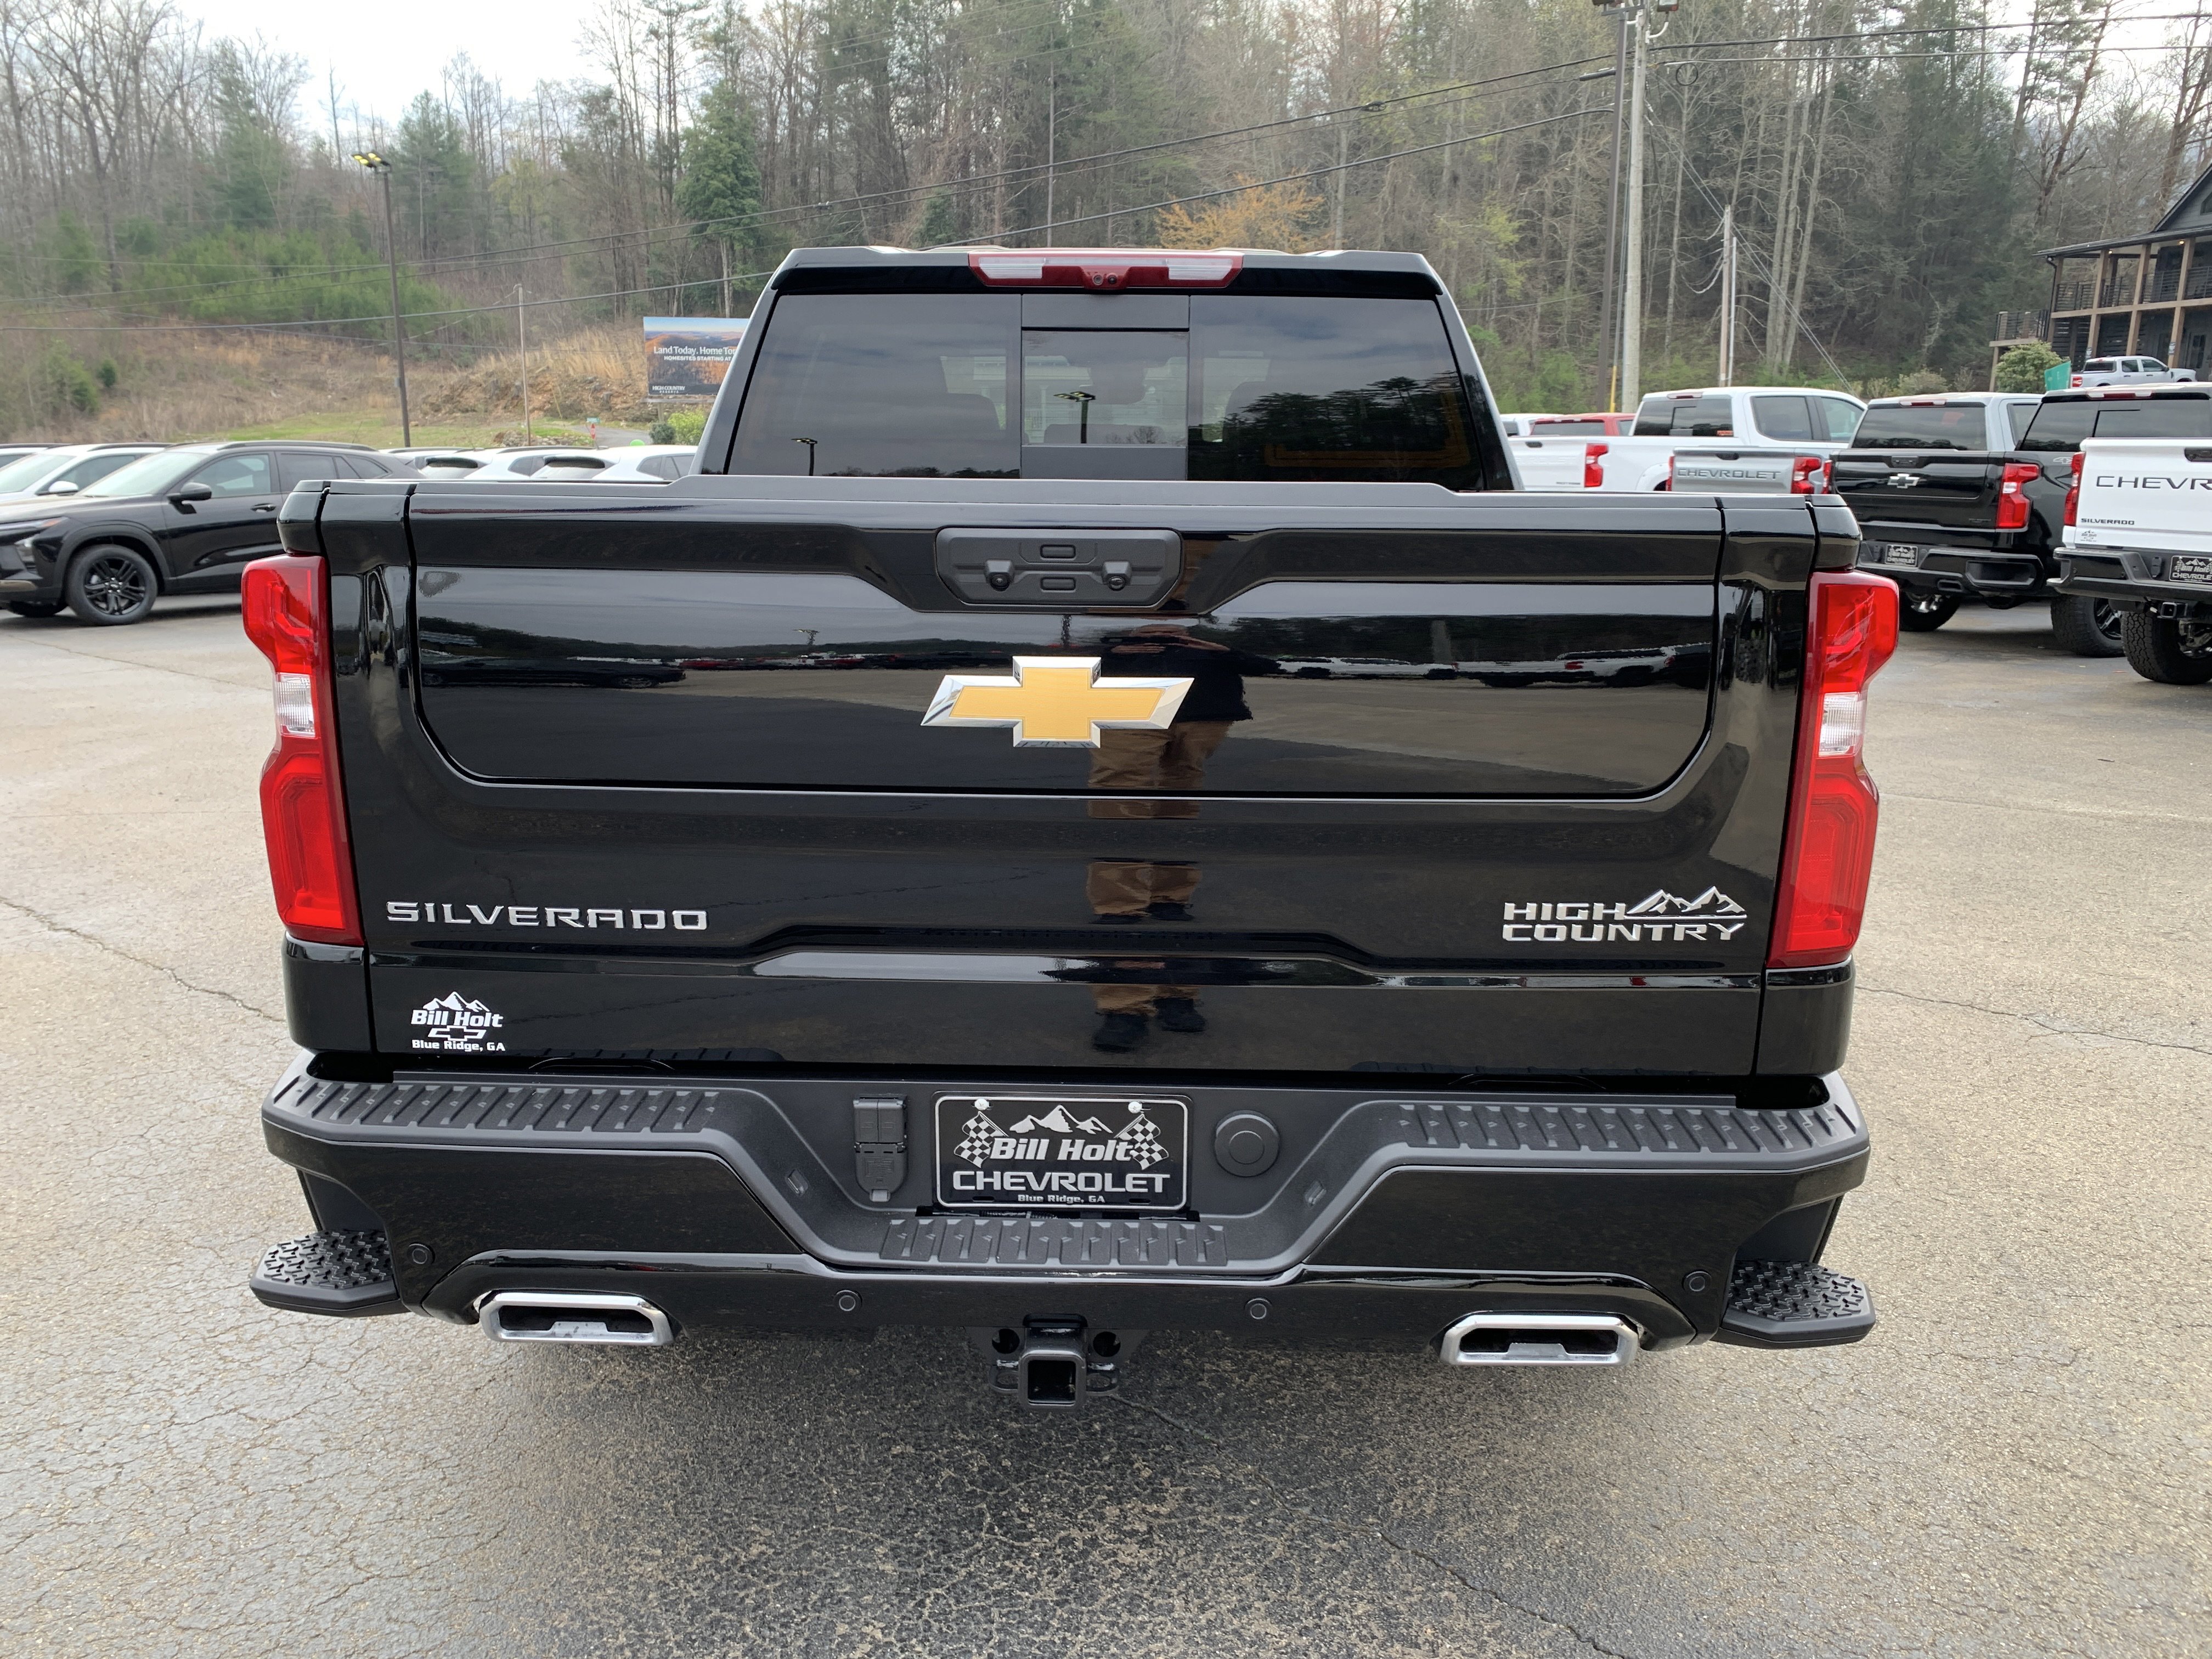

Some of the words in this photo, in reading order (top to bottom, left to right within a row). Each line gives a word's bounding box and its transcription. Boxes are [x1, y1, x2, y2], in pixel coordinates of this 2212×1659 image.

[653, 345, 673, 354] Land
[673, 346, 698, 356] Today.
[699, 346, 723, 354] Home
[1677, 469, 1781, 479] CHEVROLET
[2096, 476, 2212, 490] CHEVR
[387, 901, 708, 930] SILVERADO
[1503, 902, 1626, 921] HIGH
[1502, 923, 1745, 941] COUNTRY
[411, 1009, 449, 1025] Bill
[453, 1011, 504, 1028] Holt
[412, 1040, 440, 1049] Blue
[444, 1041, 483, 1052] Ridge,
[487, 1042, 505, 1051] GA
[990, 1138, 1049, 1160] Bill
[1057, 1139, 1136, 1161] Holt
[953, 1171, 1170, 1193] CHEVROLET
[1018, 1194, 1043, 1203] Blue
[1048, 1195, 1084, 1204] Ridge,
